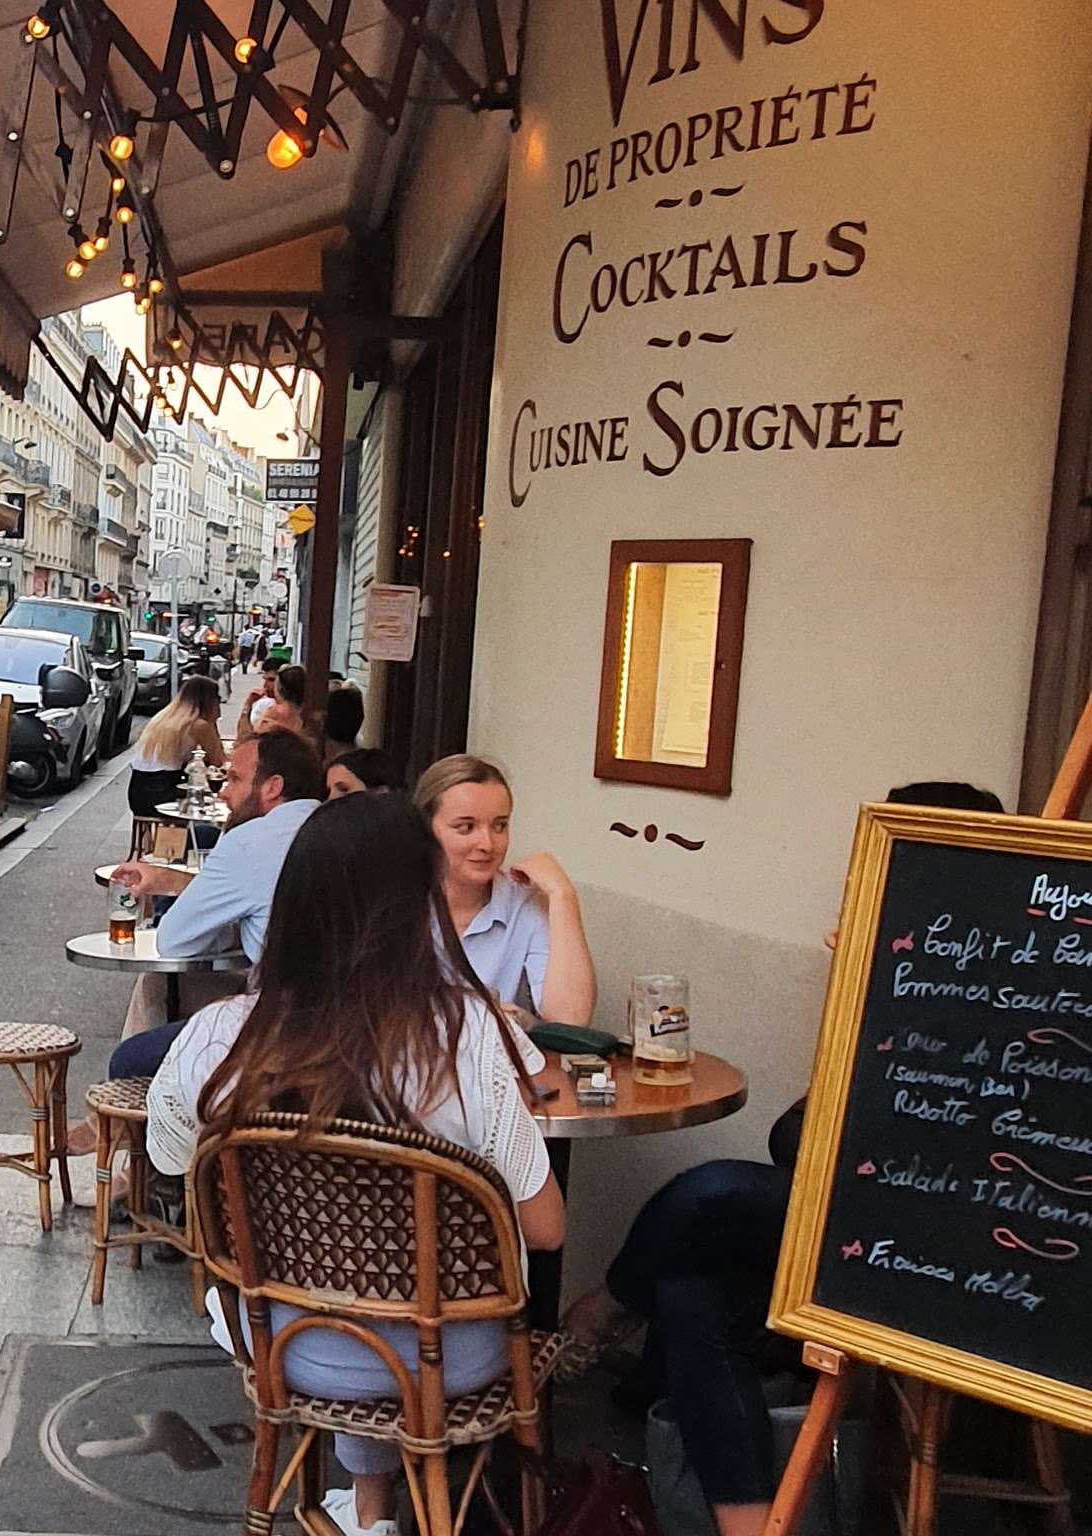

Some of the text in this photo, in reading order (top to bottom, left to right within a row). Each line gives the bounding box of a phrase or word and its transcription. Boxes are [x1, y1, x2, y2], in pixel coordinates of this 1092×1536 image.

[563, 72, 877, 209] DE PROPRIÉTÉ
[553, 221, 868, 344] COCKTAILS
[508, 380, 904, 508] CUISINE SOIGNÉE
[924, 914, 1012, 971] Confit
[1011, 930, 1041, 964] de
[894, 962, 990, 1003] Pommes
[894, 1089, 979, 1126] Risotto
[877, 1155, 959, 1193] Salade
